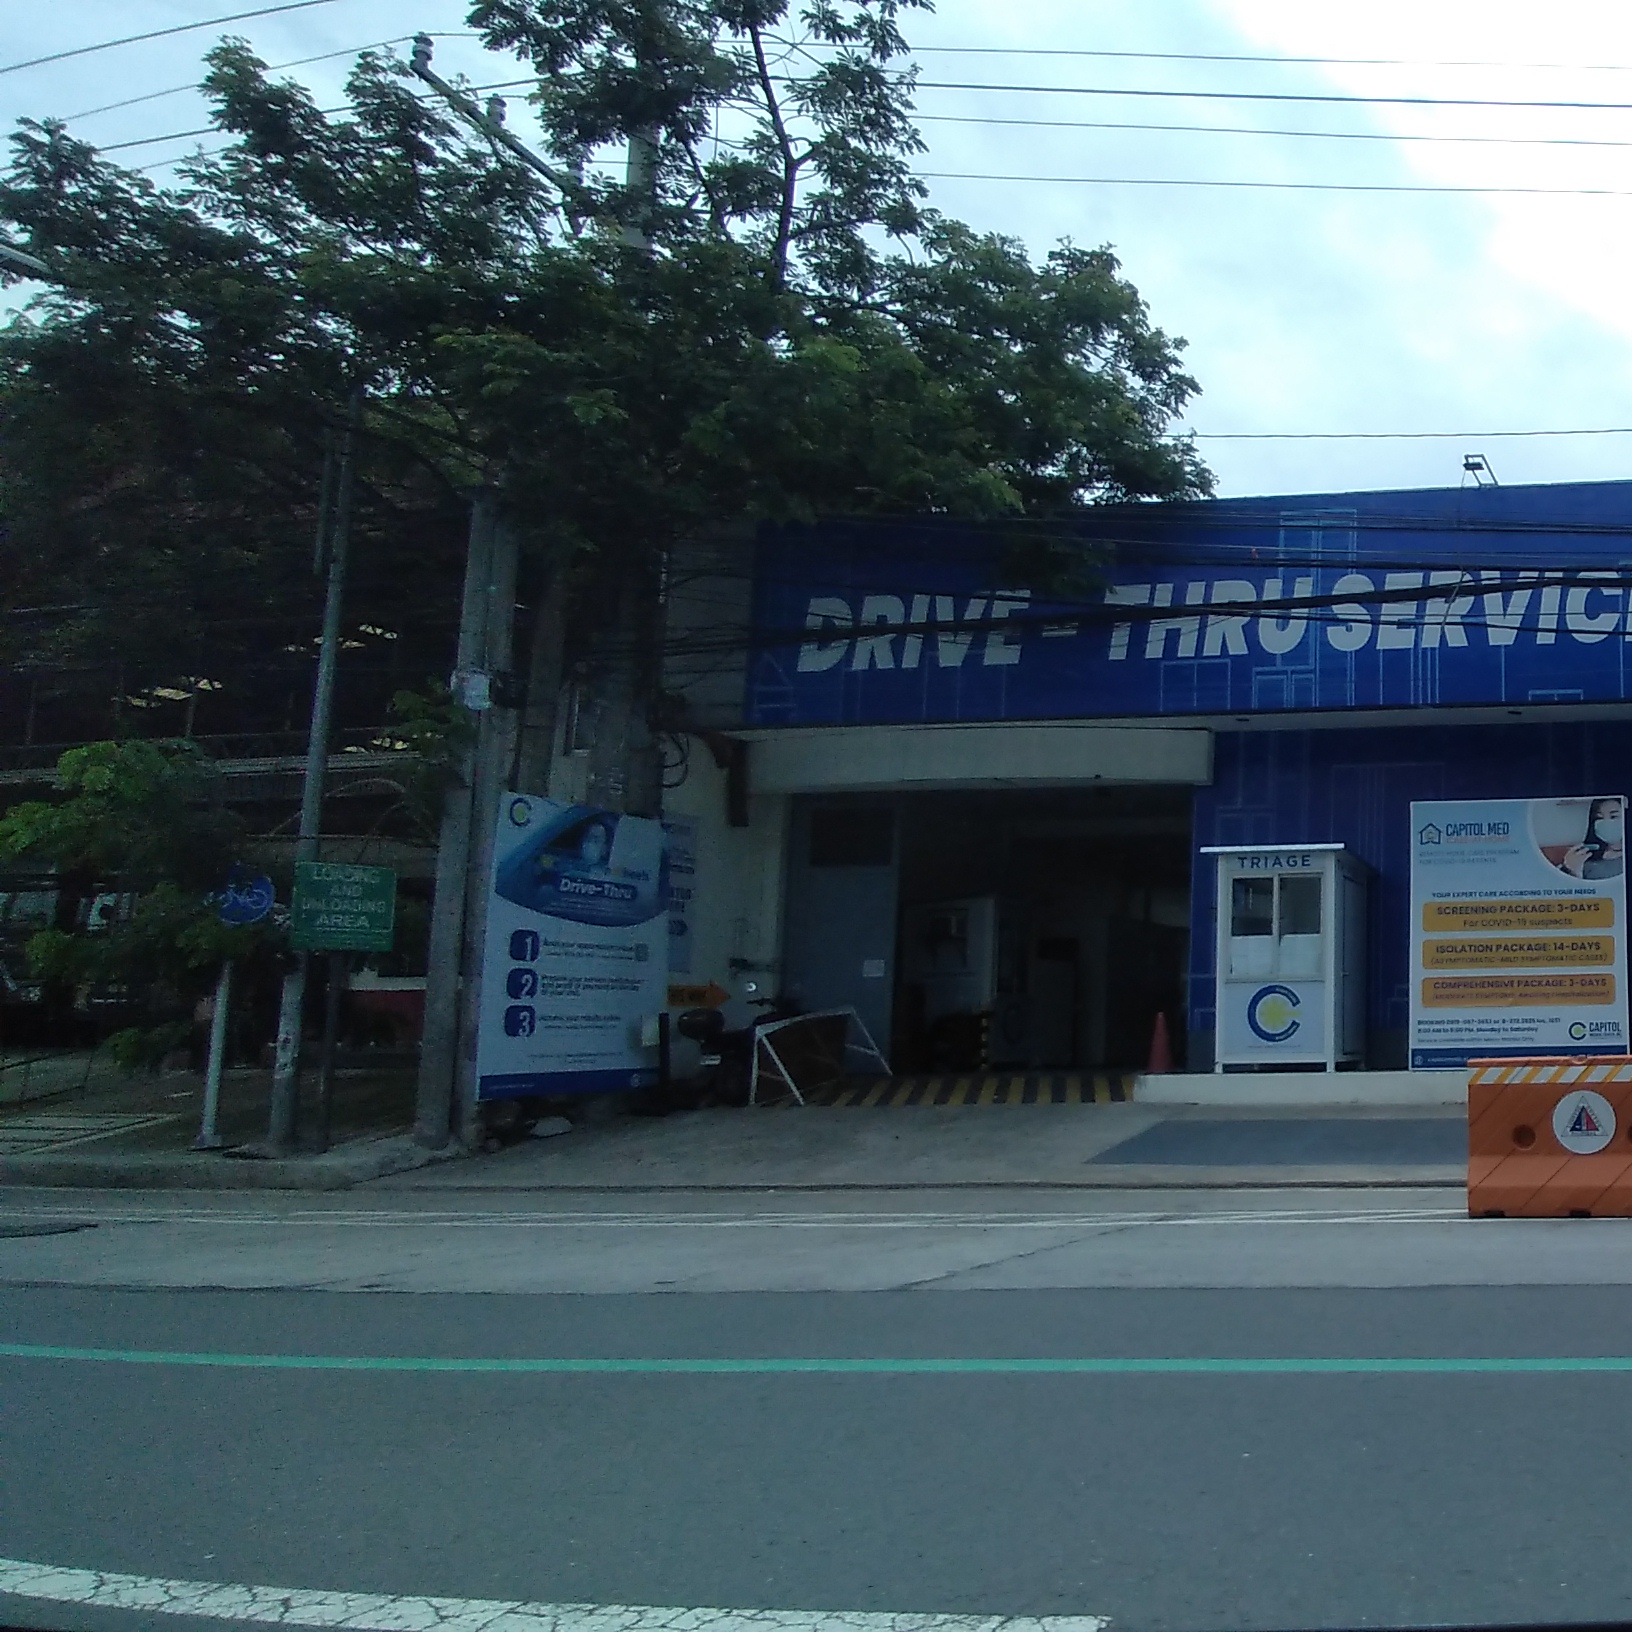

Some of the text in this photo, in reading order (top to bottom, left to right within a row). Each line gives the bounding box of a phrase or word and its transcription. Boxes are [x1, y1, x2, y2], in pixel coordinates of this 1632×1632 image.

[797, 589, 1030, 672] DRIVE
[1104, 577, 1313, 660] THRU
[1446, 821, 1510, 837] CAPITOL MED
[1238, 854, 1311, 868] TRIAGE
[312, 867, 382, 885] LOADING
[329, 884, 363, 898] AND
[560, 878, 632, 899] Drive-Thru
[1437, 902, 1600, 916] SCREENING PACKAGE: 3-DAYS
[317, 913, 370, 928] AREA
[1463, 917, 1573, 929] For COVID-19 suspects
[524, 936, 533, 961] 1
[1436, 941, 1601, 954] ISOLATION PACKAGE: 14-DAYS
[522, 974, 533, 996] 2
[1433, 980, 1515, 990] COMPREHENSIVE
[1517, 978, 1567, 989] PACKAGE:
[520, 1012, 530, 1037] 3
[1589, 1021, 1621, 1032] CAPITOL
